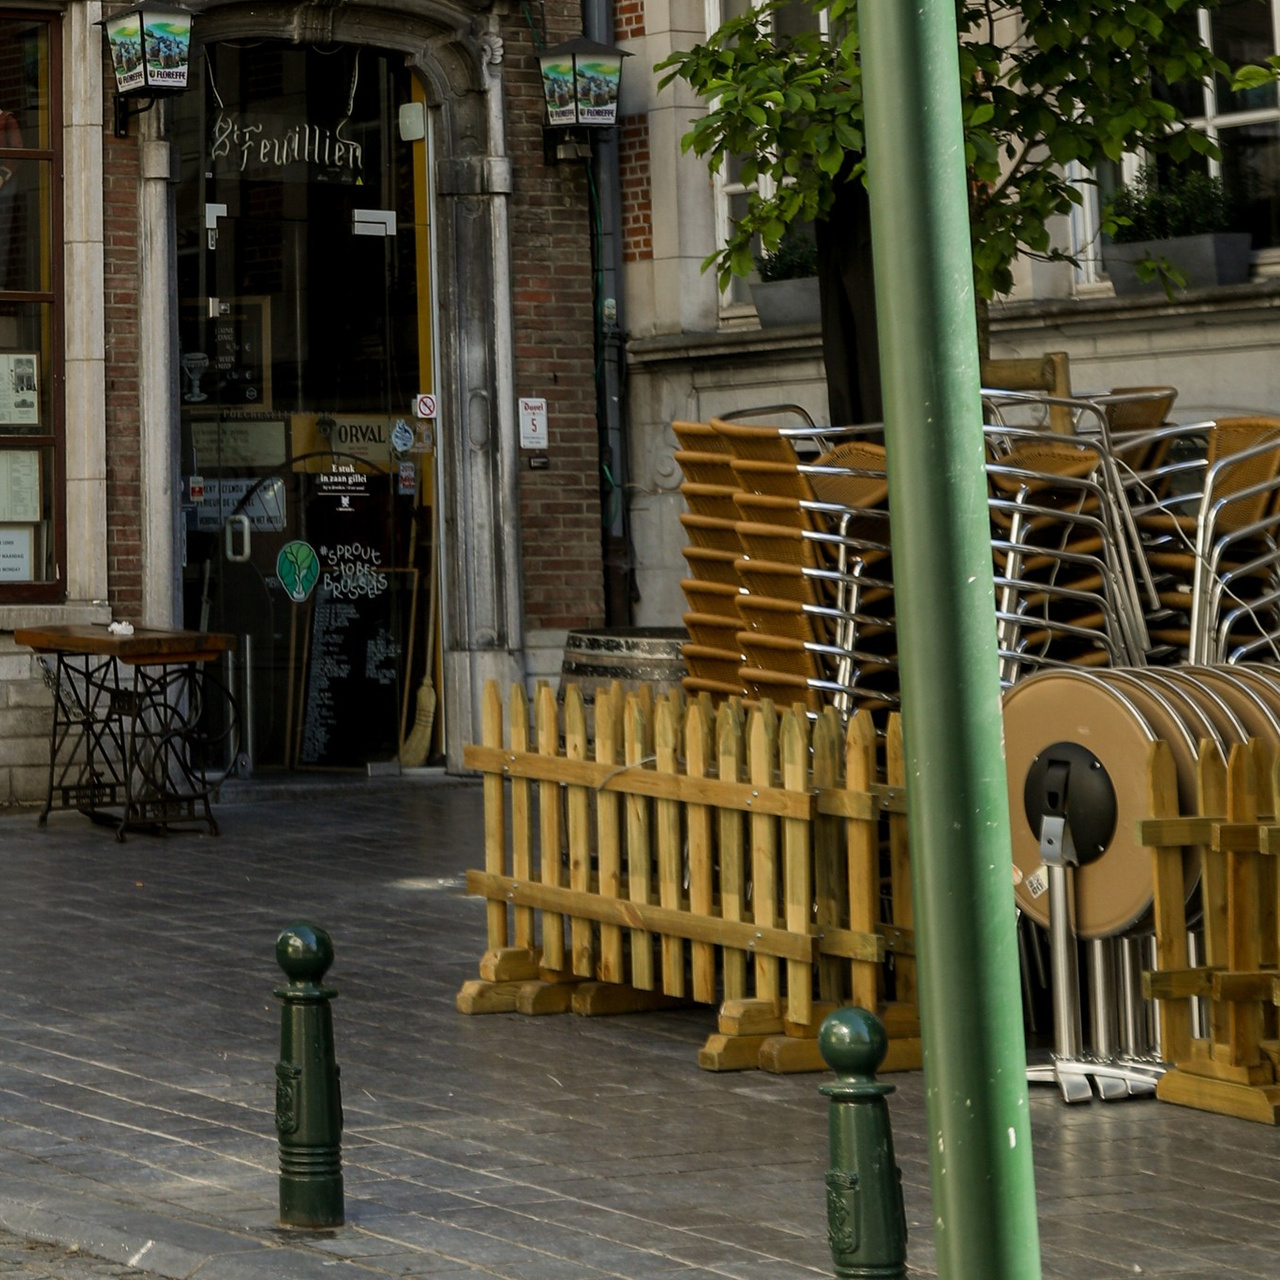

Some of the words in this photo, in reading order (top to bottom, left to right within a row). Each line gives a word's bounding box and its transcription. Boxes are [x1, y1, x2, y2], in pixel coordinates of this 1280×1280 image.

[157, 70, 186, 80] FLOREFFE
[524, 402, 544, 411] Duvel
[531, 419, 537, 433] 5
[338, 424, 385, 444] ORVAL
[323, 573, 388, 601] BRUSSELS
